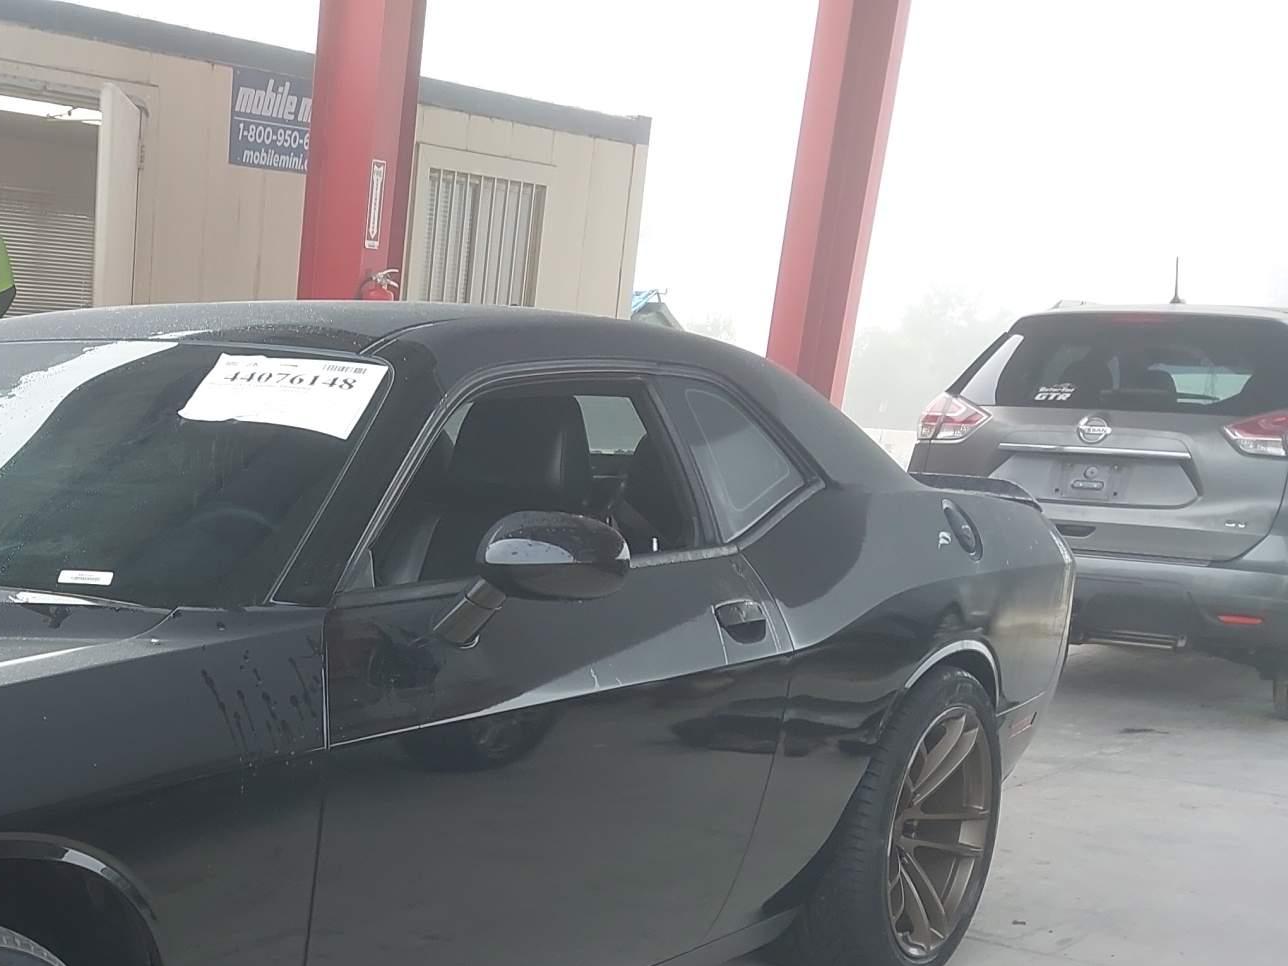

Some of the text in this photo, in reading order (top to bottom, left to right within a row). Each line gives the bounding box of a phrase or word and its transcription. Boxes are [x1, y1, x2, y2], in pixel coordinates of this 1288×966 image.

[235, 78, 298, 120] mobile
[238, 122, 310, 150] 1-800-950-6
[223, 371, 357, 391] 44076148
[1034, 392, 1072, 401] GTR
